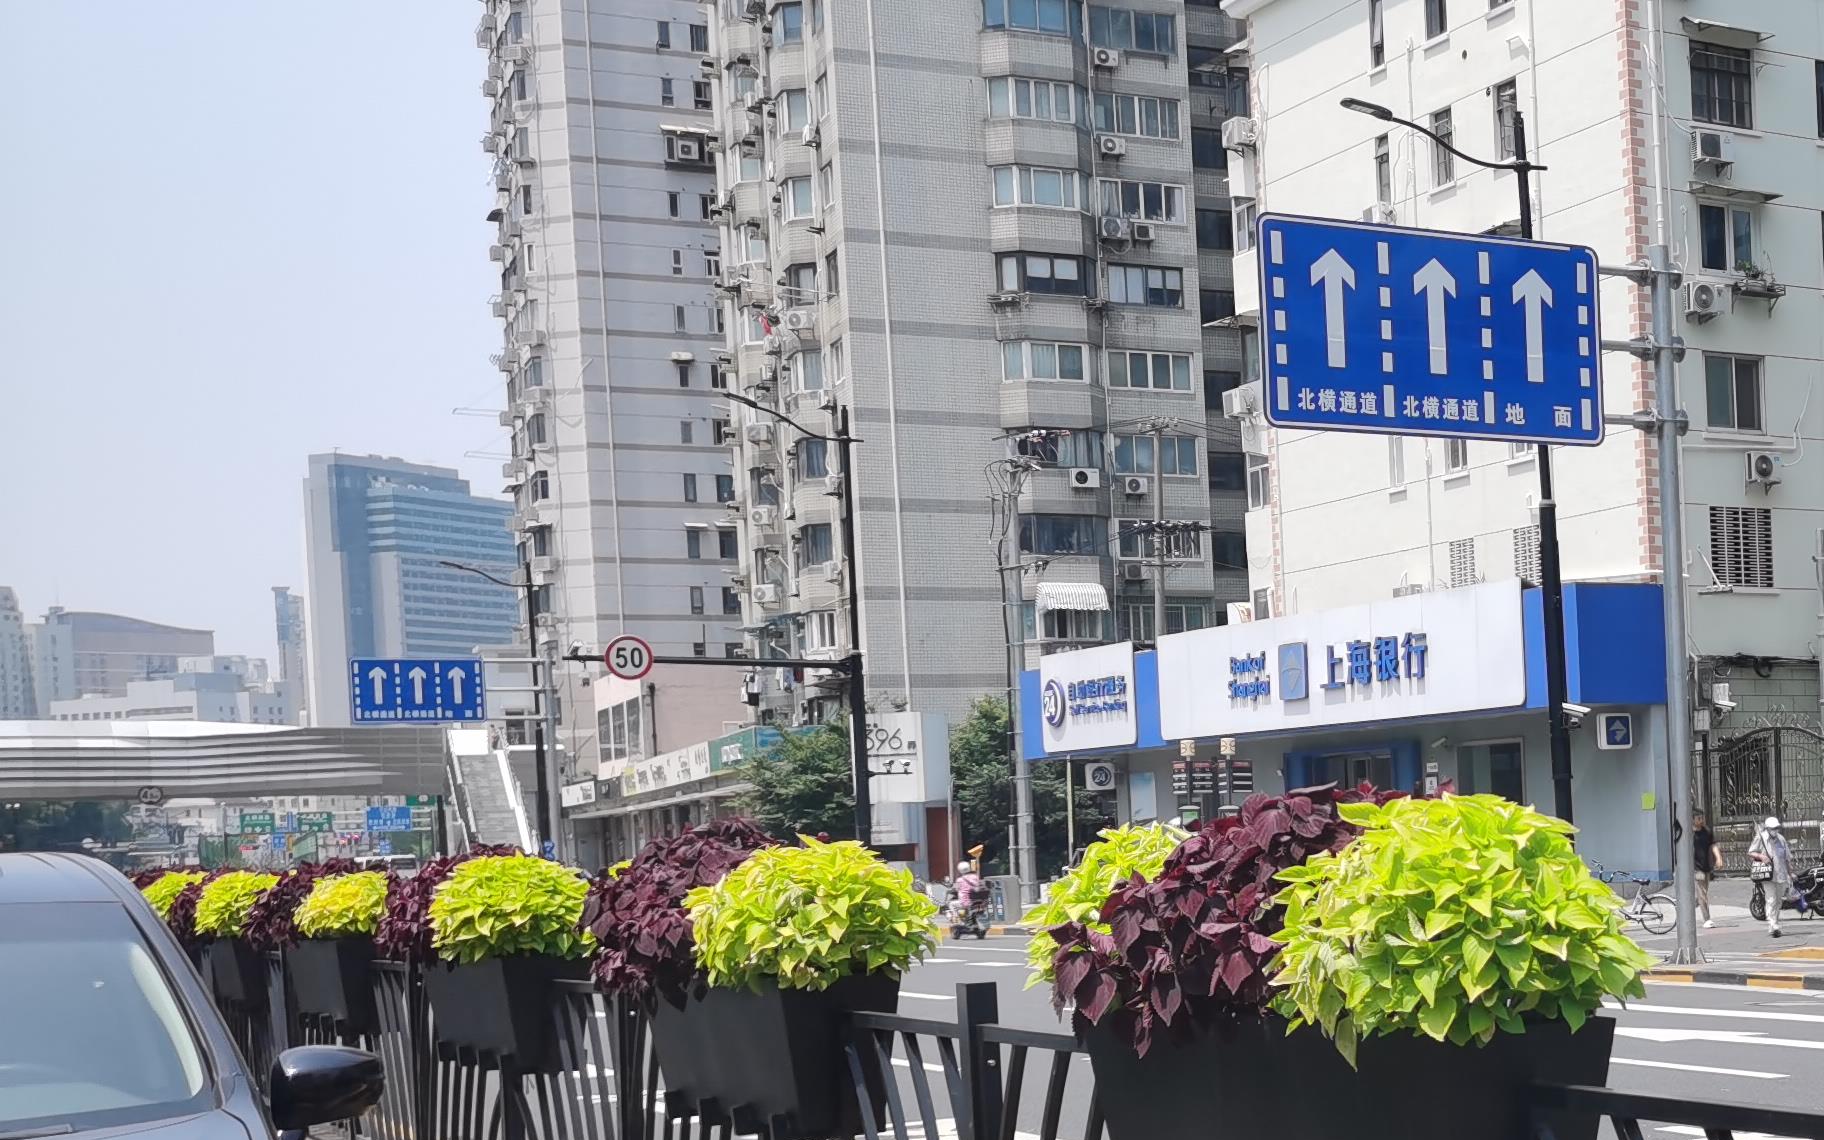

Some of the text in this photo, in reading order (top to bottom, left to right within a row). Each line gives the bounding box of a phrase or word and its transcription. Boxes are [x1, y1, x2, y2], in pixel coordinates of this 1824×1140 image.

[1297, 387, 1378, 416] 北横通道
[1403, 395, 1480, 422] 北横通道
[1505, 402, 1572, 428] 地面
[616, 647, 643, 668] 50
[1320, 632, 1428, 689] 上海银行
[1228, 675, 1270, 701] Shanghai
[1044, 696, 1056, 717] 24
[1094, 771, 1107, 782] 24
